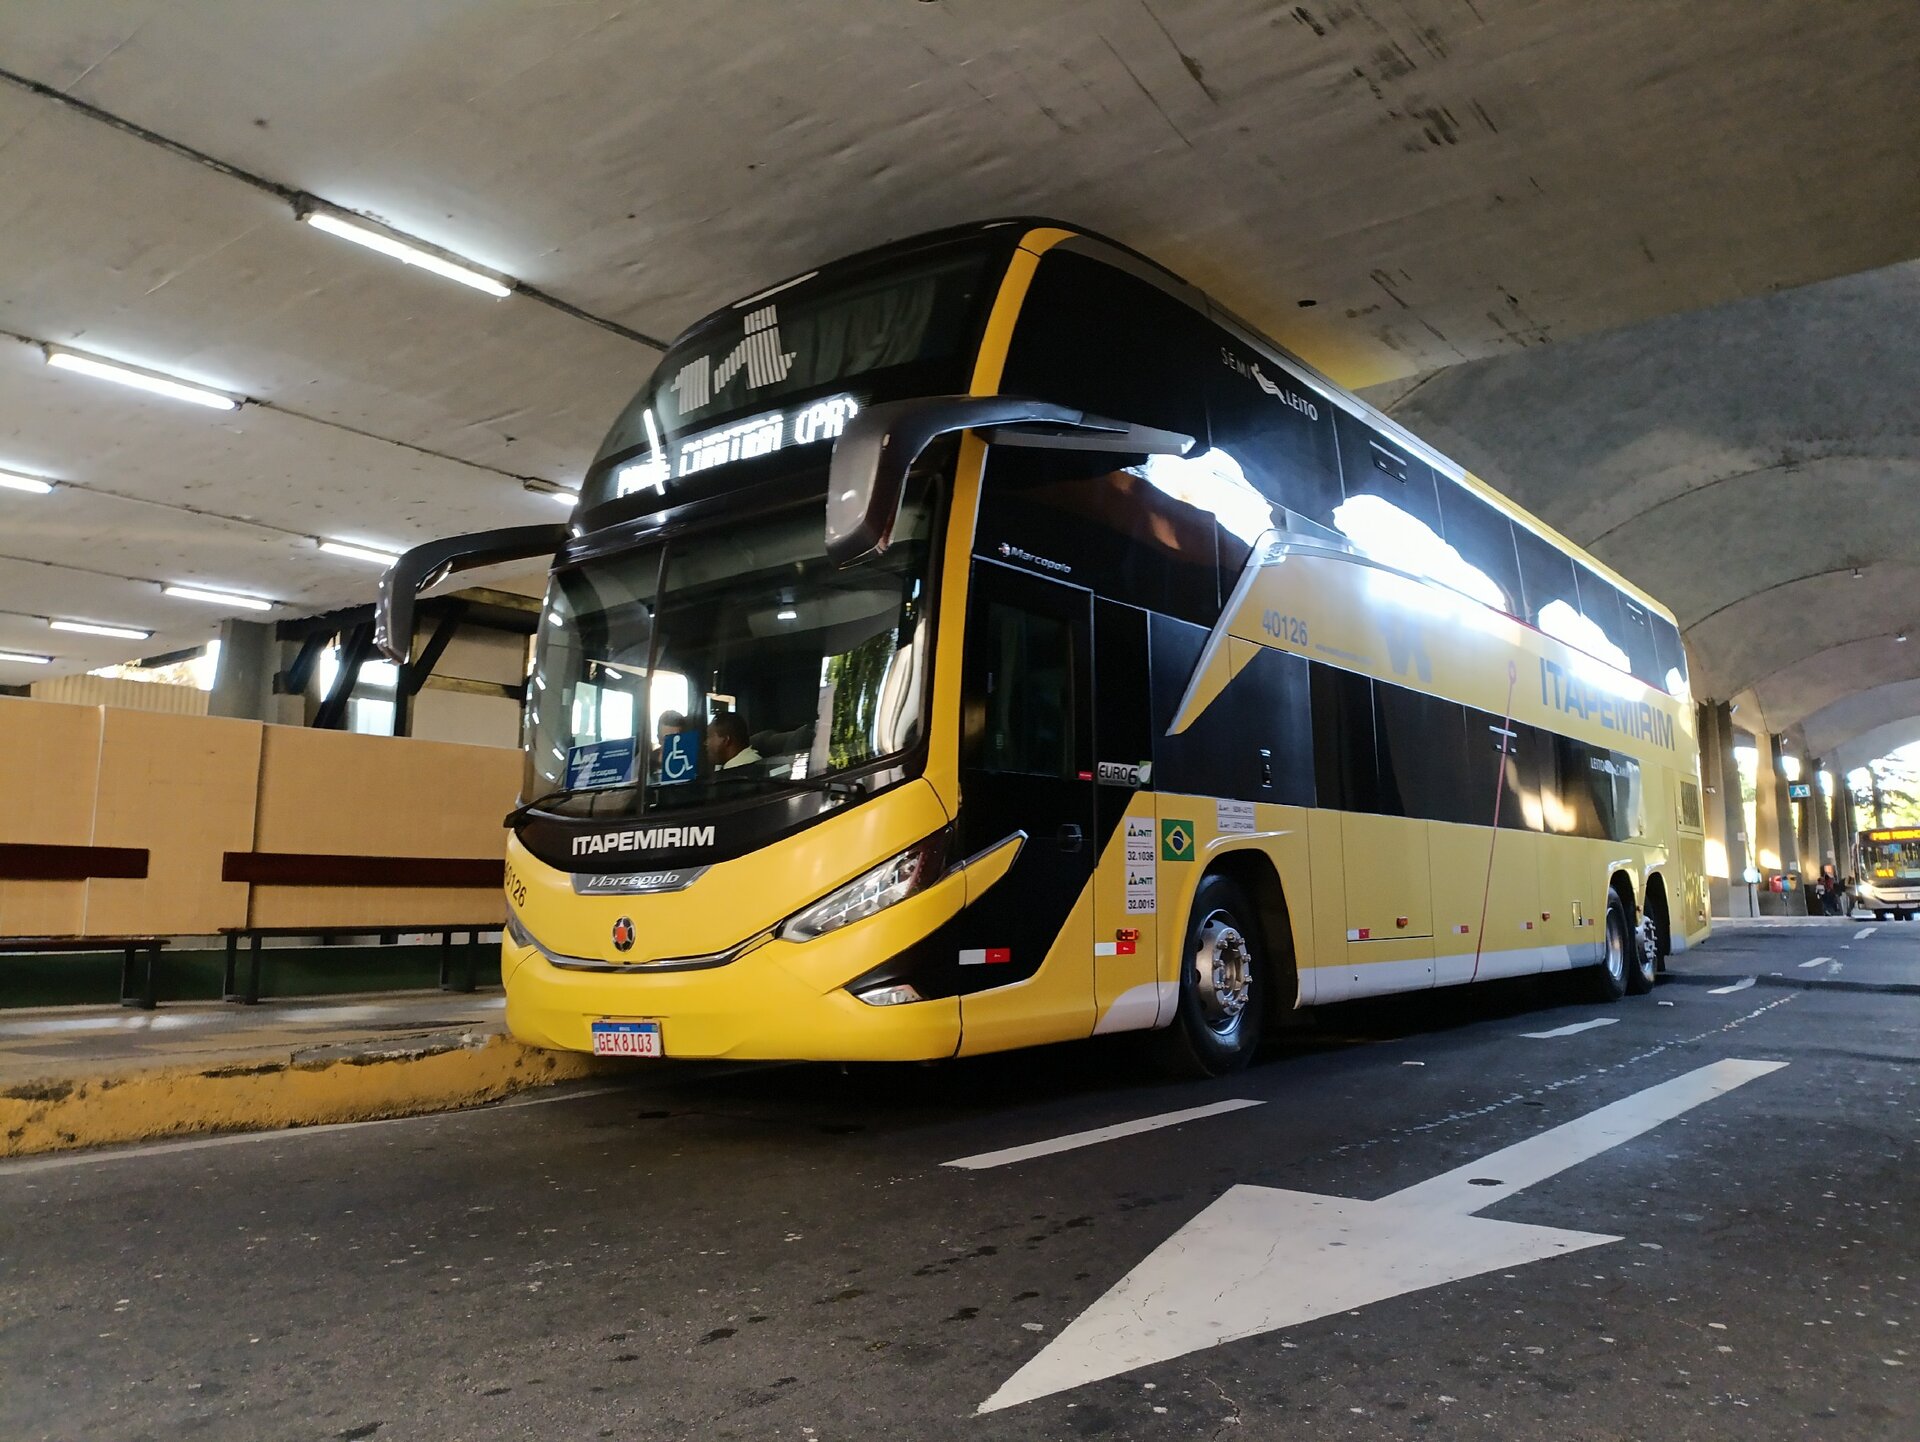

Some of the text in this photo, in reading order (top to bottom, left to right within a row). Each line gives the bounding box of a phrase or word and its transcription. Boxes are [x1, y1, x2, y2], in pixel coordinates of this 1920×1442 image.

[1221, 347, 1318, 421] SEMI LEITO
[1011, 546, 1072, 573] Marcopolo
[1262, 608, 1308, 647] 40126
[1539, 656, 1675, 752] ITAPEMIRIM
[572, 826, 716, 856] ITAPEMIRIM
[587, 871, 681, 888] Marcopolo
[1127, 899, 1156, 910] 32.0015
